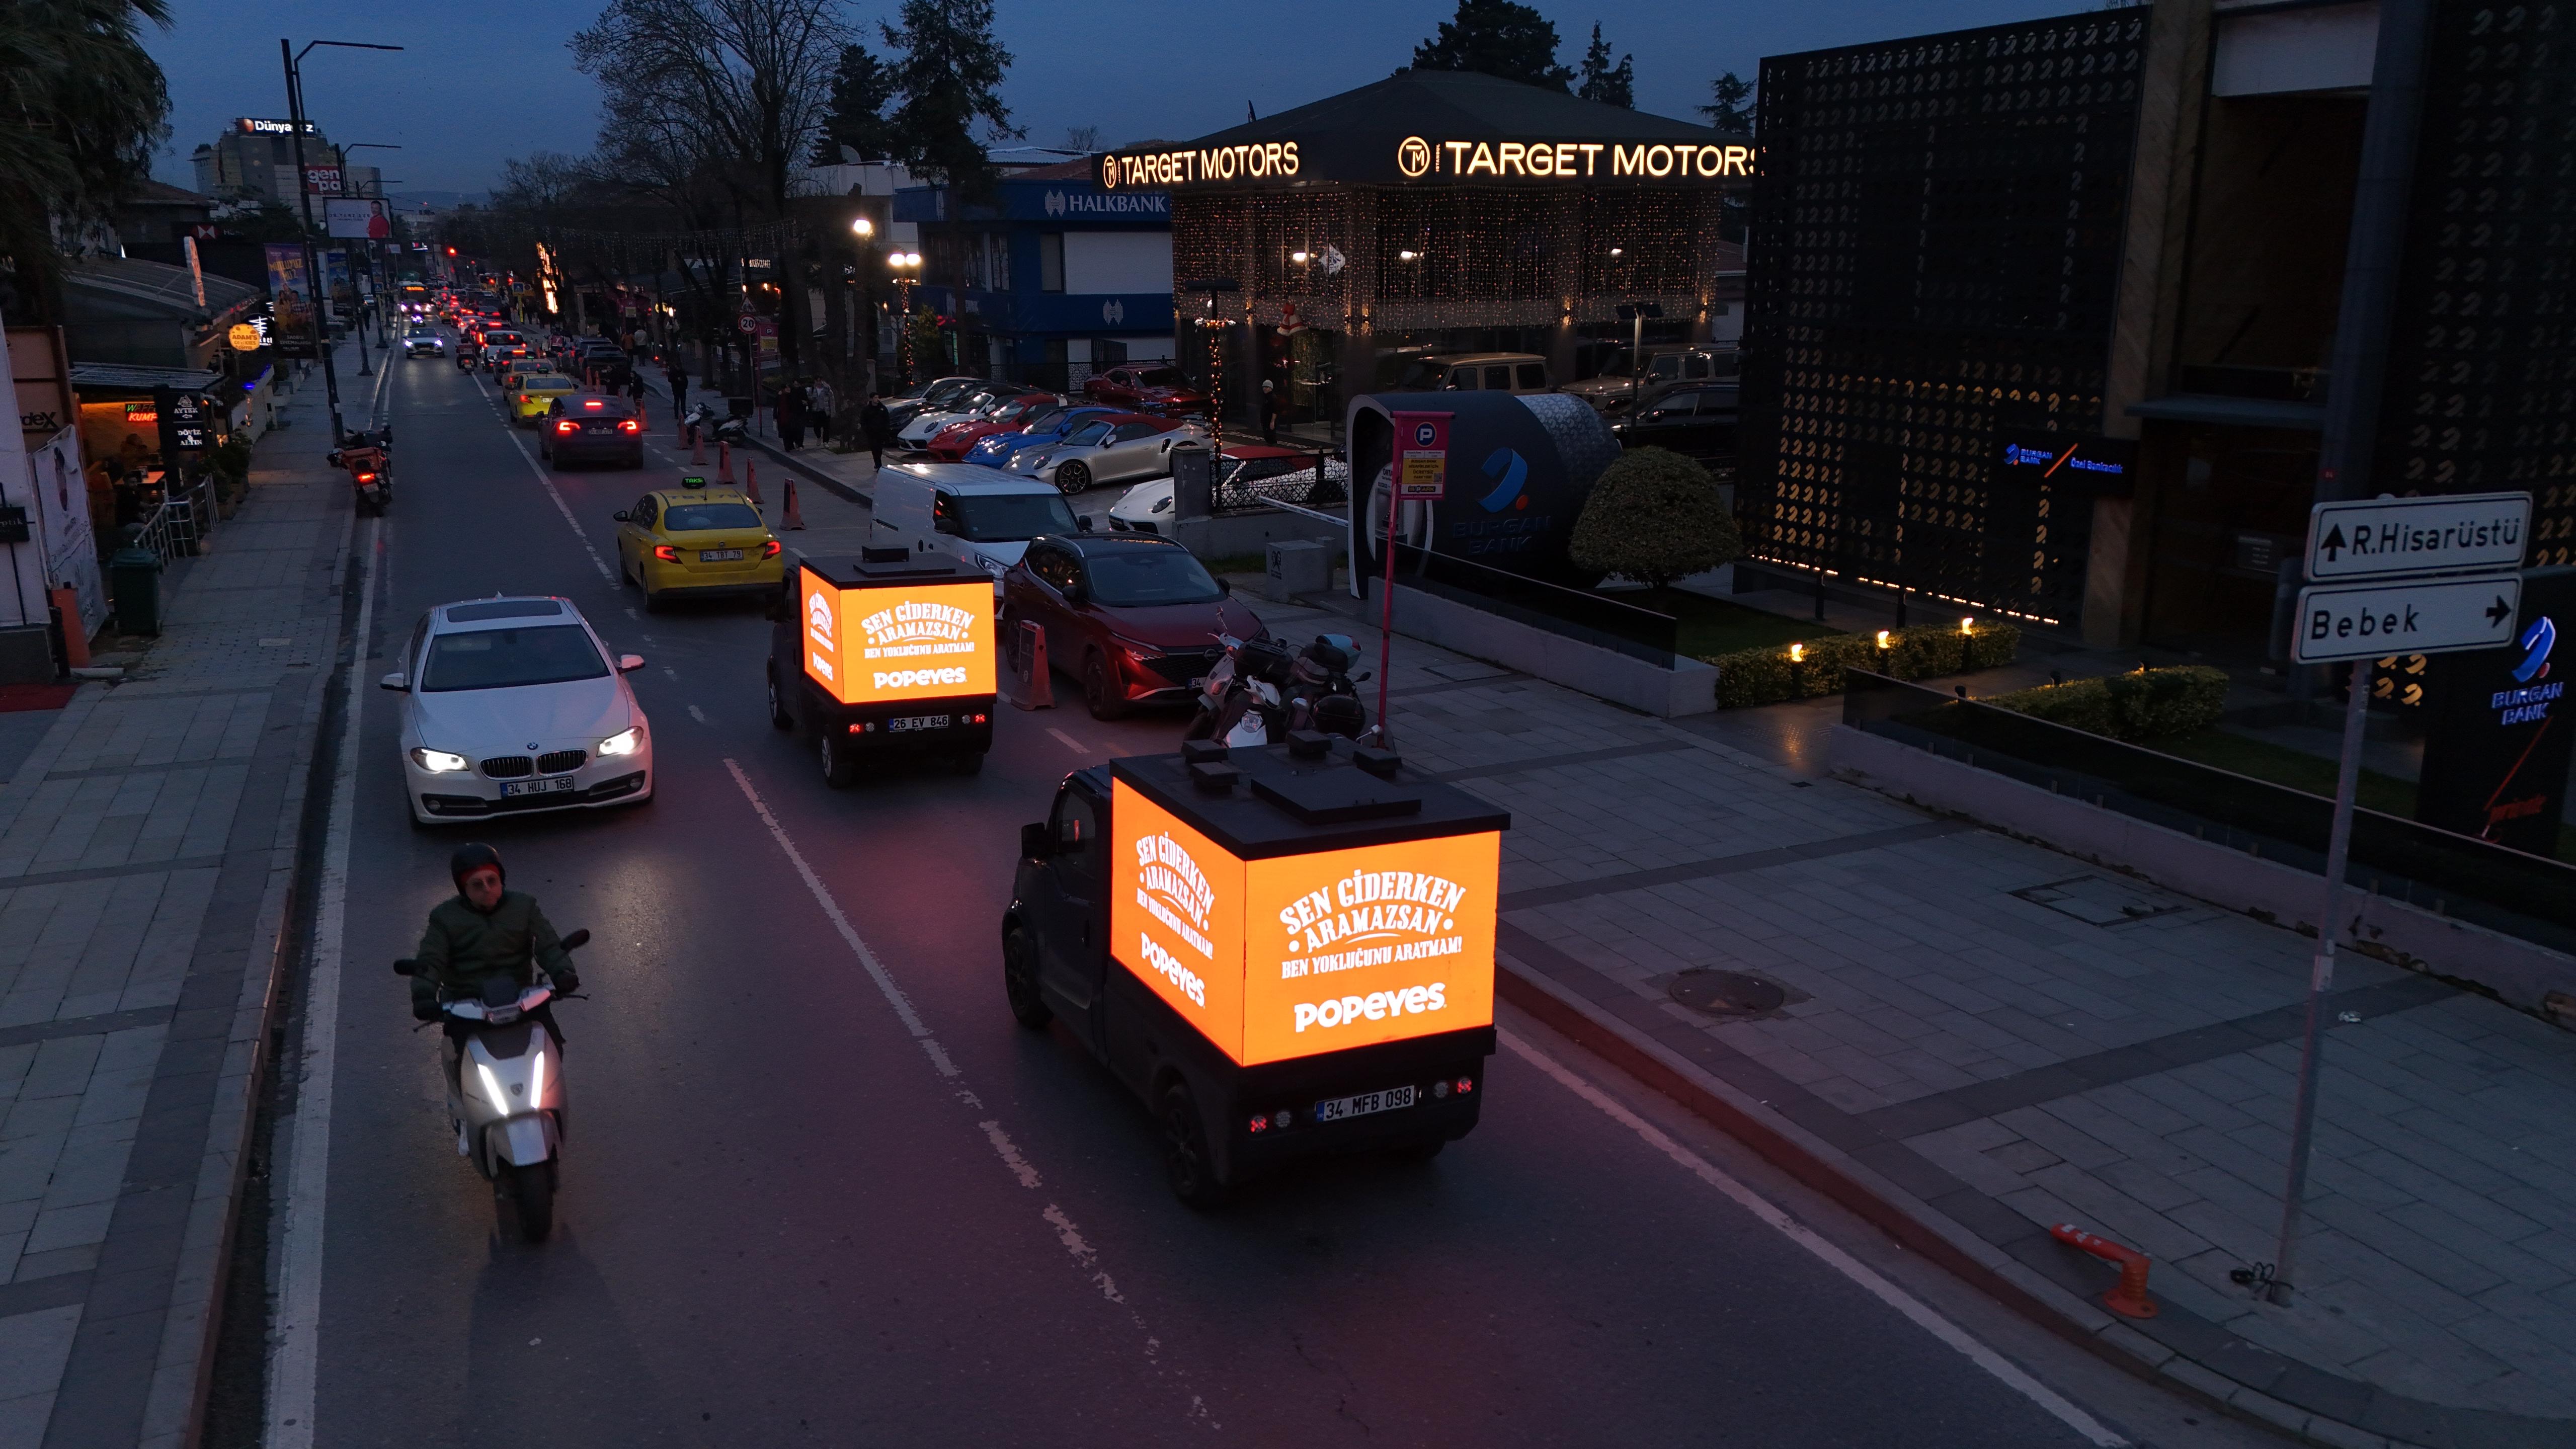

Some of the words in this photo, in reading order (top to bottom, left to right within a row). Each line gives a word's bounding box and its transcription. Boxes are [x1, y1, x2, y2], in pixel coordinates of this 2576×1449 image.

[1121, 151, 1196, 185] TARGET
[1201, 141, 1299, 180] MOTORS
[1445, 141, 1604, 176] TARGET
[1070, 195, 1166, 212] HALKBANK
[743, 319, 754, 328] 20
[2020, 456, 2041, 465] BANK
[2021, 448, 2052, 459] BURGAN
[1453, 516, 1551, 539] BURGAN
[2352, 518, 2520, 555] R.Hisarüstü
[1468, 536, 1533, 555] BANK
[861, 609, 894, 635] SEN
[895, 601, 975, 629] GİDERKEN
[877, 618, 962, 646] ARAMAZSAN
[2311, 603, 2420, 639] Bebek
[864, 648, 882, 659] BEN
[933, 641, 975, 655] ARATMAM!
[2491, 681, 2564, 709] BURGAN
[894, 719, 906, 729] 26
[912, 717, 925, 728] EV
[931, 716, 947, 726] 846
[2501, 702, 2550, 726] BANK
[508, 784, 520, 794] 34
[528, 781, 546, 792] HUJ
[555, 778, 572, 789] 168
[1136, 835, 1157, 867] SEN
[1158, 831, 1216, 915] GİDERKEN
[1145, 865, 1203, 928] ARAMAZSAN
[1279, 886, 1332, 935] SEN
[1337, 869, 1467, 913] GİDERKEN
[1137, 887, 1148, 908] BEN
[1181, 924, 1214, 960] ARATMAM!
[1304, 904, 1443, 953] ARAMAZSAN
[1281, 958, 1309, 980] BEN
[1312, 947, 1392, 975] YOKLUĞUNU
[1394, 936, 1463, 962] ARATMAM!
[1326, 1100, 1343, 1119] 34
[1352, 1094, 1379, 1115] MFB
[1386, 1088, 1411, 1107] 098
